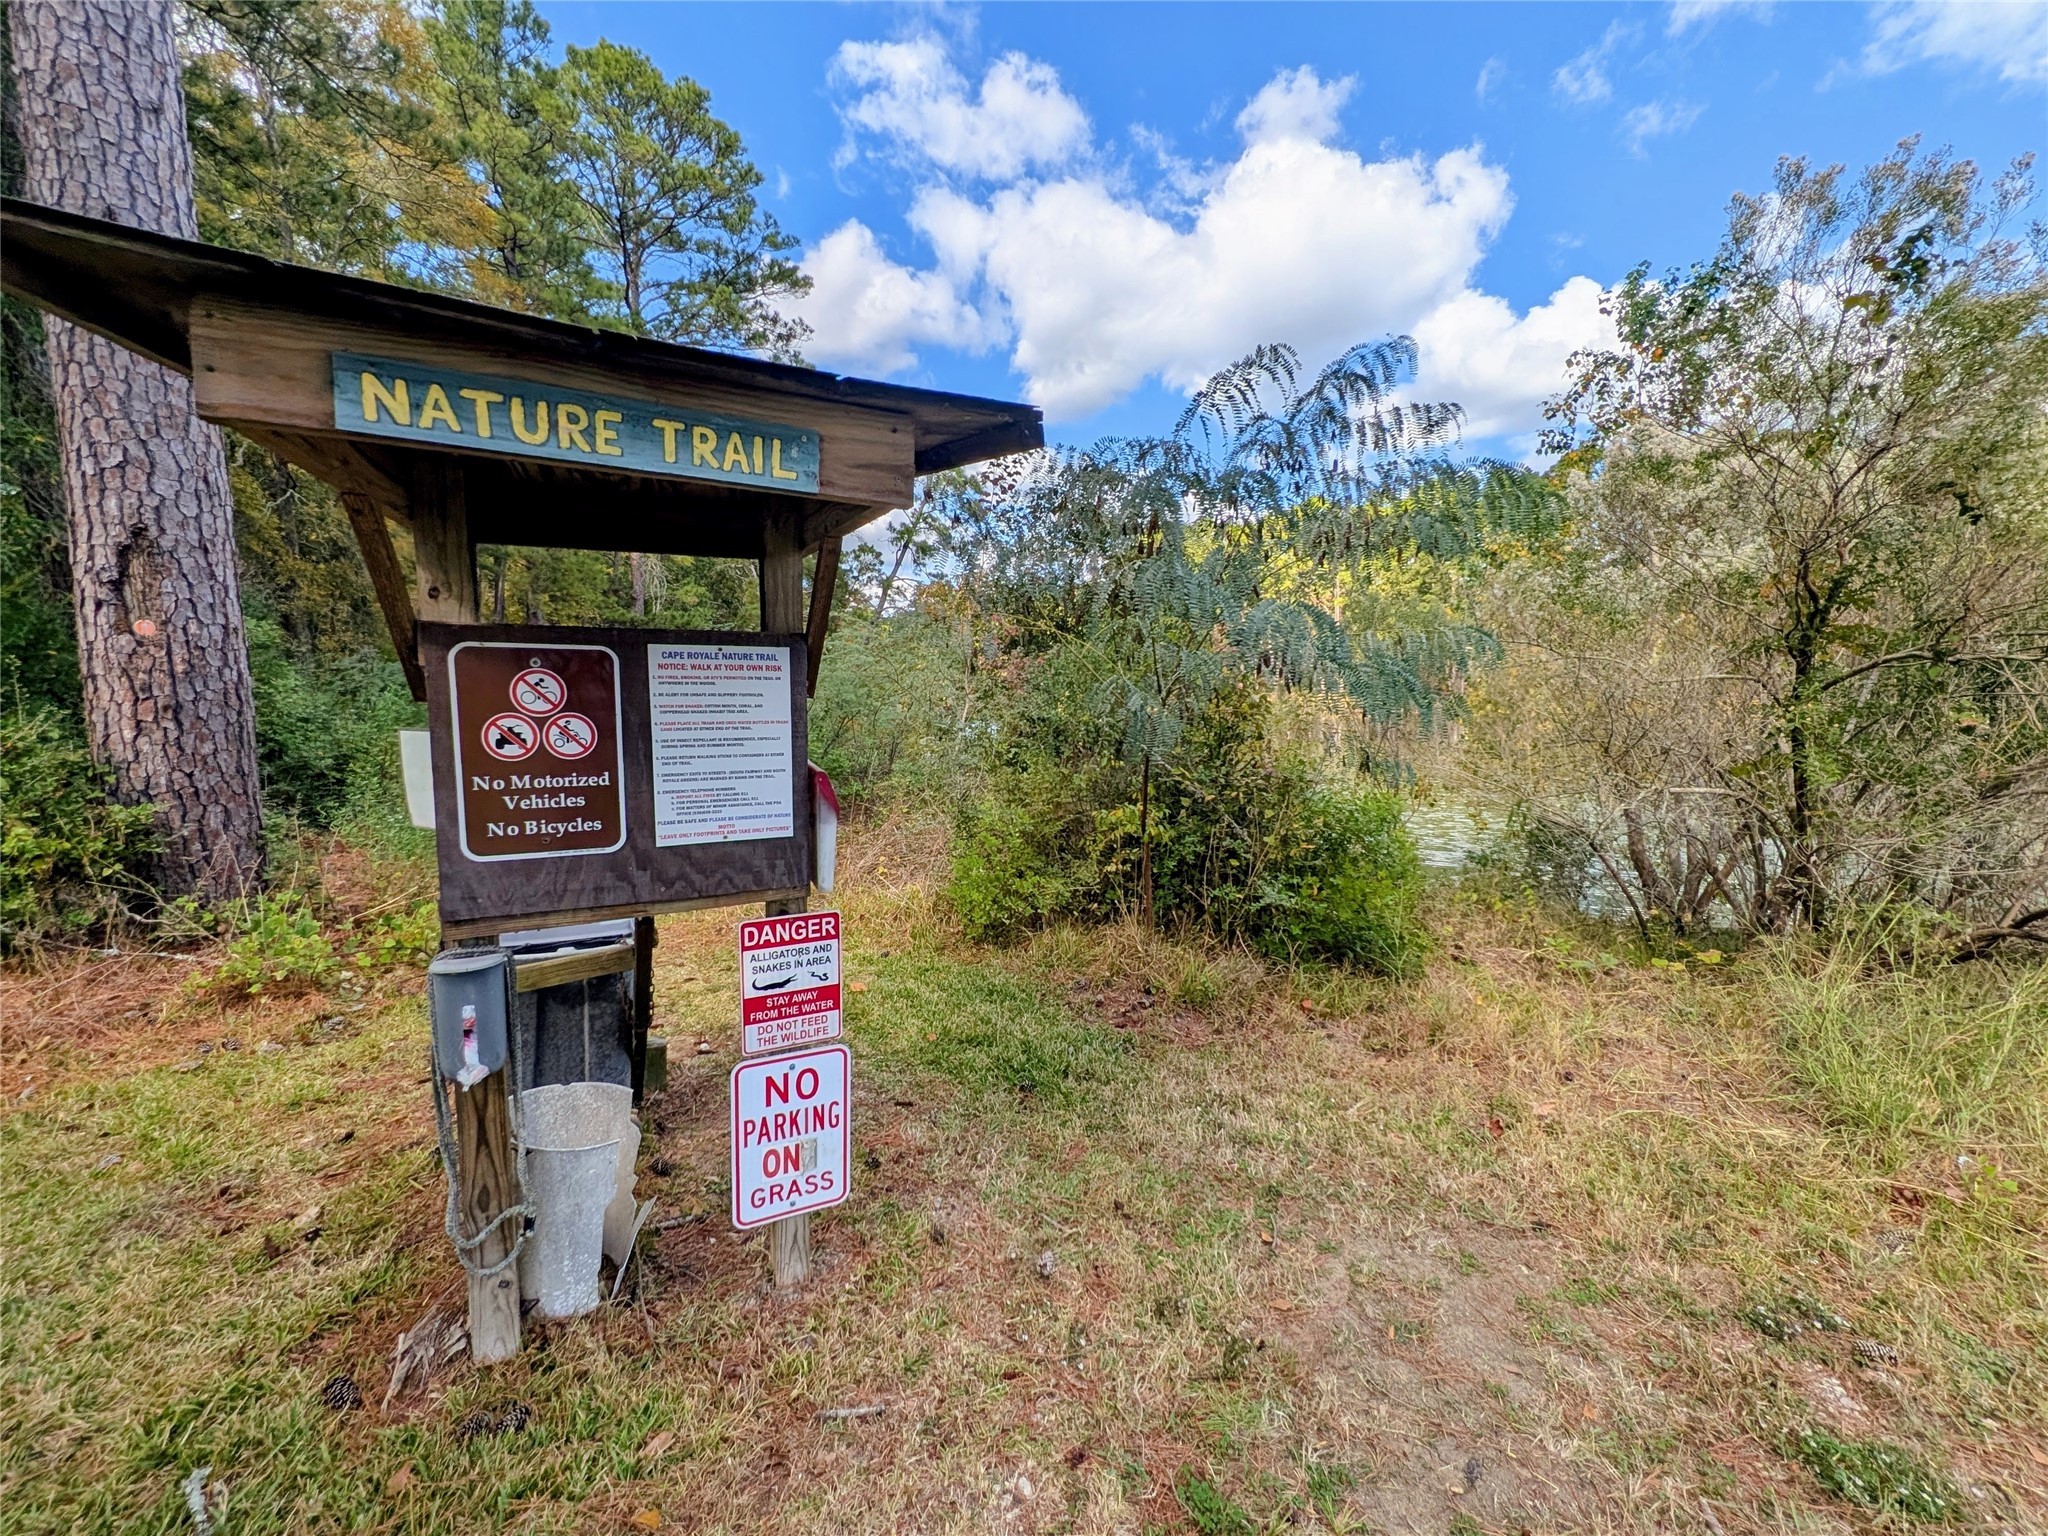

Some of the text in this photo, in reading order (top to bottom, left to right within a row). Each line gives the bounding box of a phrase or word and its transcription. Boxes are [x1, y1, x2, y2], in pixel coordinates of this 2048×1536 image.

[360, 372, 797, 480] NATURE TRAIL
[662, 651, 778, 662] CAPE ROYALE NATURE TRAIL
[658, 663, 782, 672] NOTICE: WALK AT YOUR OWN RISK
[473, 772, 610, 790] No Motorized
[503, 793, 585, 810] Vehicles
[487, 818, 602, 837] No Bicycles
[694, 830, 725, 838] FOOTPRINTS
[766, 825, 791, 833] PICTURES"
[744, 917, 836, 946] DANGER
[750, 944, 832, 963] ALLIGATORS AND
[752, 956, 831, 974] SNAKES IN AREA
[766, 991, 818, 1007] STAY AWAY
[750, 1000, 833, 1021] FROM THE WATER
[758, 1015, 827, 1035] DO NOT FEED
[757, 1026, 829, 1047] THE WILDLIFE
[765, 1067, 819, 1108] NO
[744, 1101, 840, 1148] PARKING
[763, 1143, 800, 1178] ON
[751, 1171, 834, 1209] GRASS
